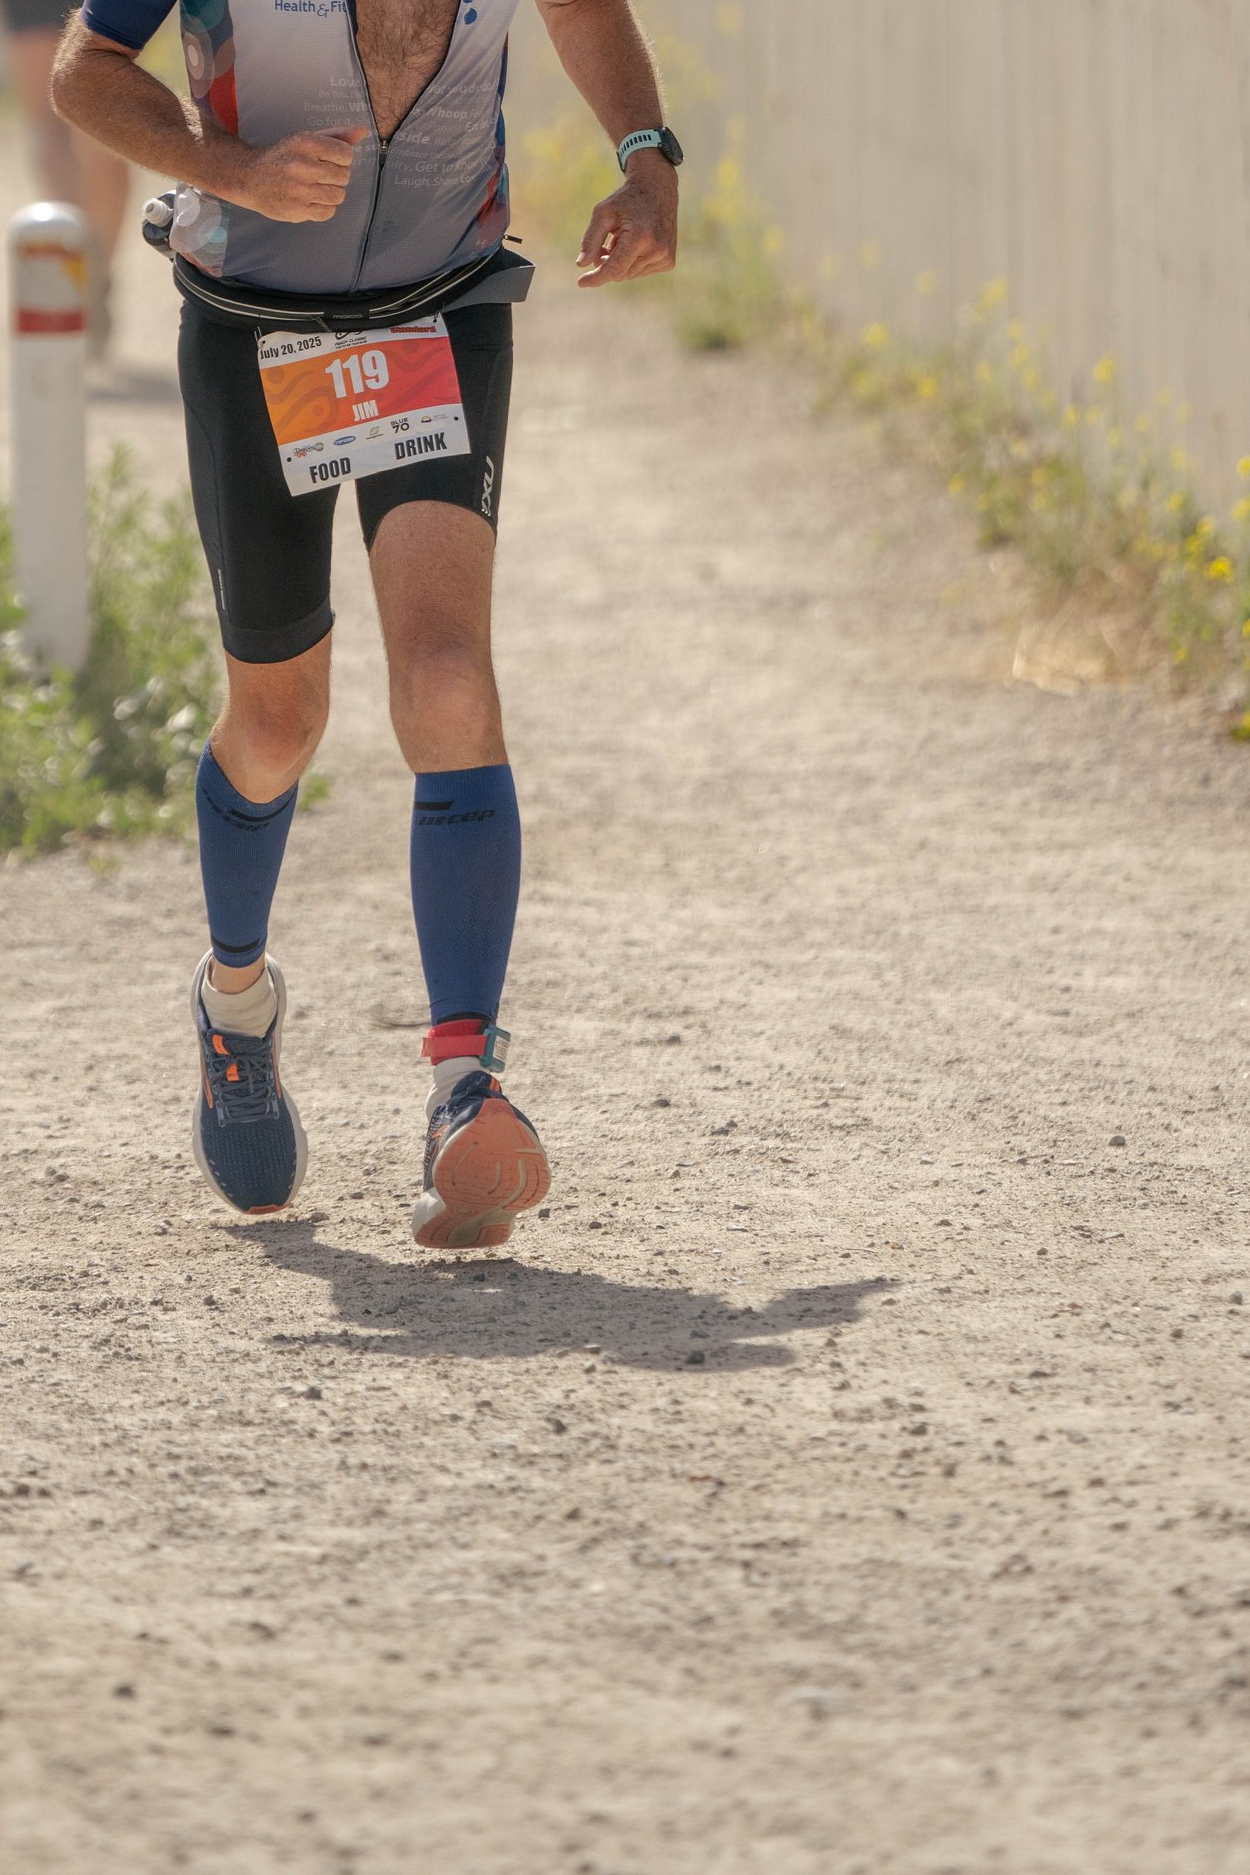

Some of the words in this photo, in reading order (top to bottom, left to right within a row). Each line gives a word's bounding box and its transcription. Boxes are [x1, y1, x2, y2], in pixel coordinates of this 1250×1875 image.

[275, 0, 316, 12] Health
[317, 4, 329, 18] &
[260, 347, 280, 360] July
[281, 343, 297, 355] 20,
[297, 336, 322, 352] 2025
[324, 349, 390, 399] 119
[352, 400, 379, 422] JIM
[392, 422, 410, 433] 70
[394, 432, 447, 461] DRINK
[309, 457, 351, 484] FOOD
